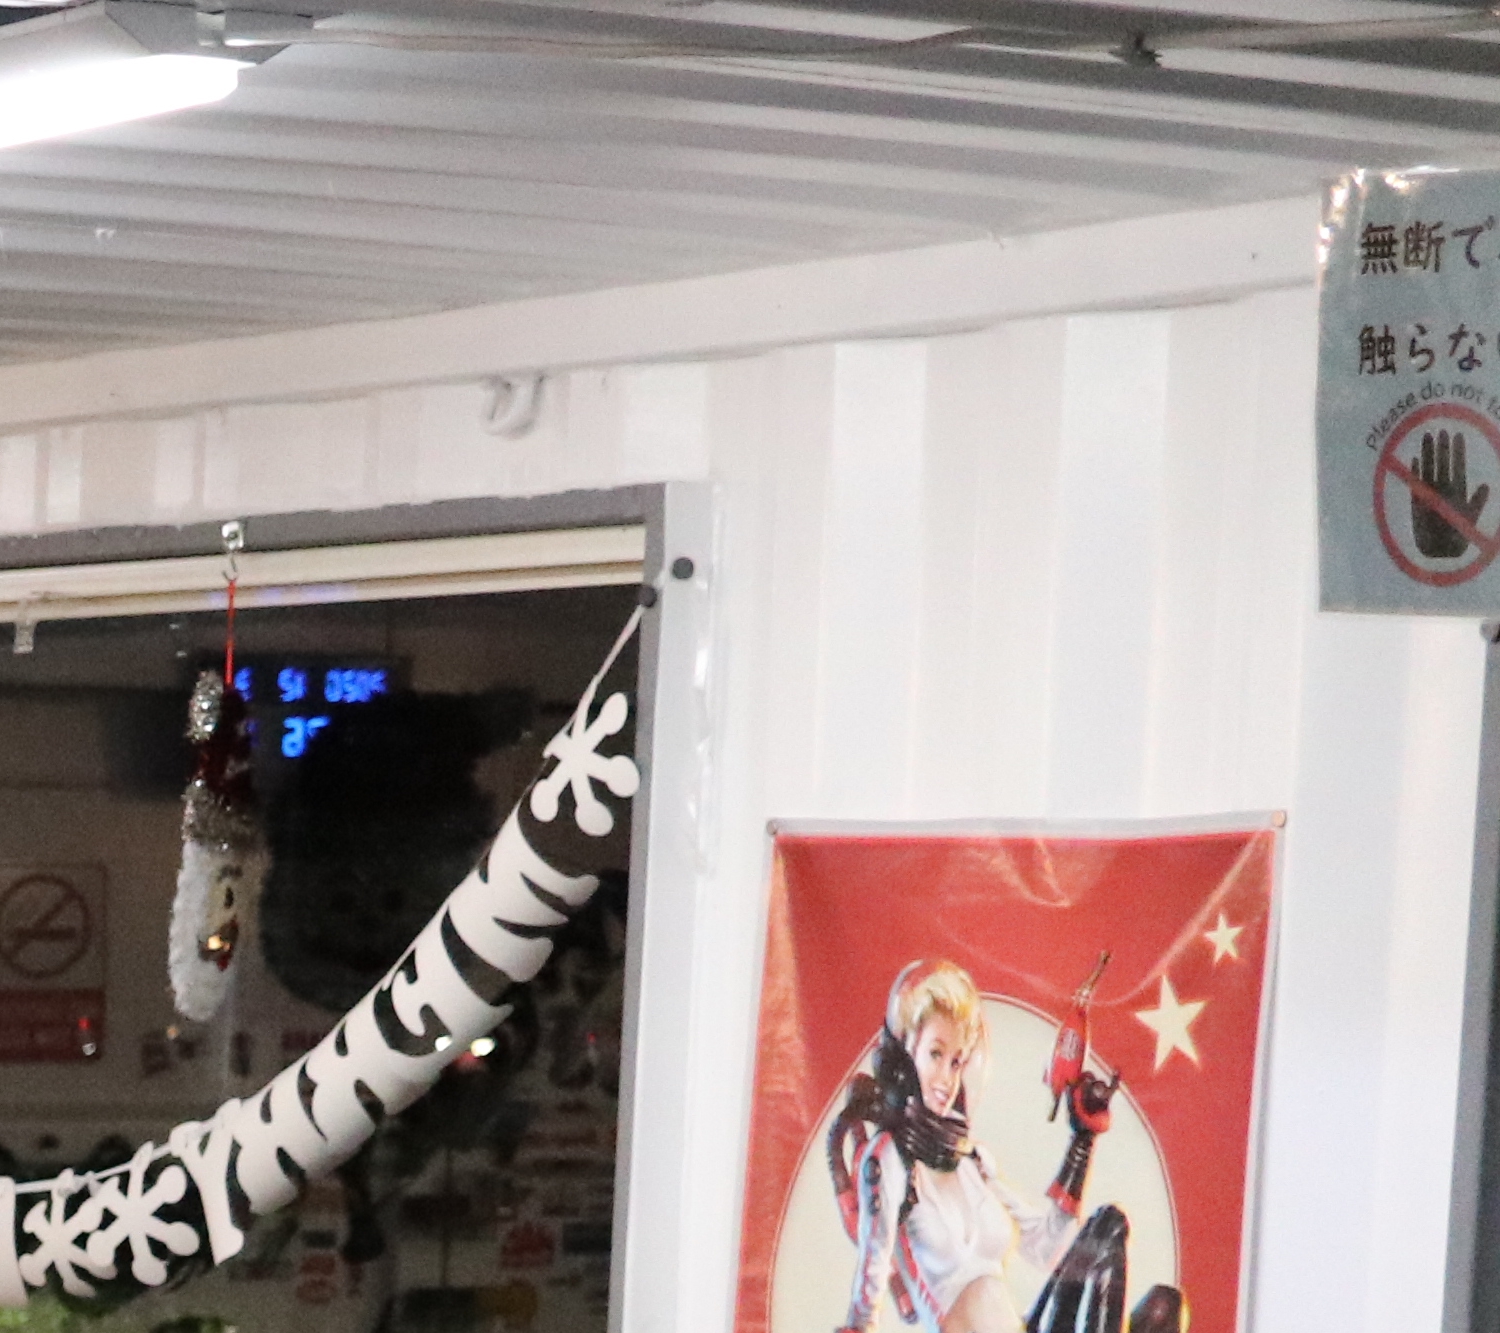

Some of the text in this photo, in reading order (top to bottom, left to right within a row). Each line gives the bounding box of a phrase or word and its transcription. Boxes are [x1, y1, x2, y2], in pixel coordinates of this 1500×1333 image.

[1365, 380, 1484, 452] Please do not
